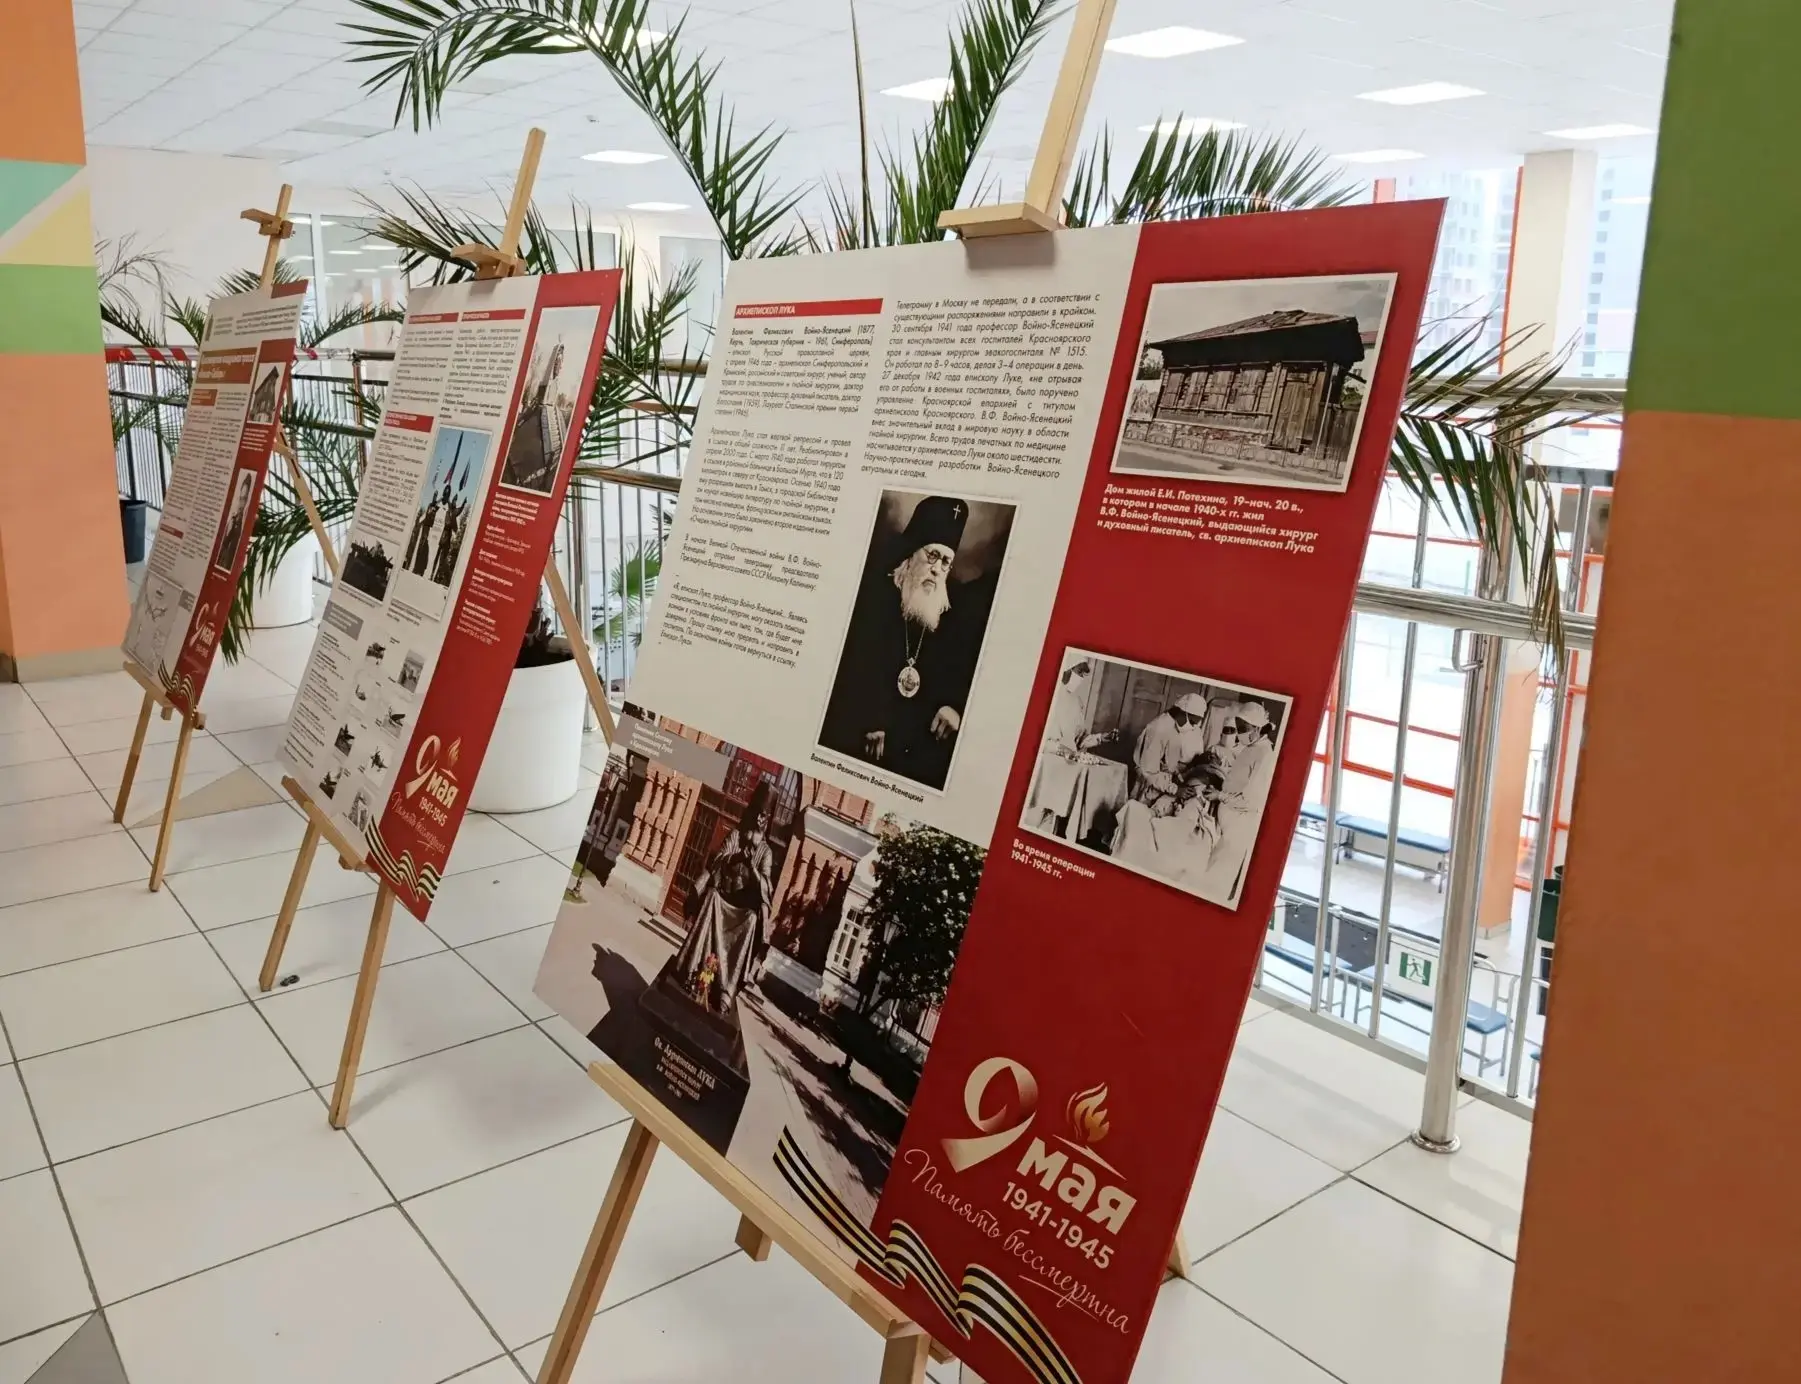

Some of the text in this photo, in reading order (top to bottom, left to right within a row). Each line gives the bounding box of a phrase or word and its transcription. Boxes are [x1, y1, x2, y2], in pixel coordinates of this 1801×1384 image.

[1104, 484, 1124, 494] Дом
[1125, 488, 1156, 496] жилой
[1157, 489, 1175, 499] Е.И.
[1109, 498, 1147, 508] котором
[1155, 503, 1190, 512] начале
[1193, 504, 1226, 516] 1940-х
[1242, 512, 1264, 520] жил
[1099, 506, 1118, 516] В.Ф.
[1208, 521, 1275, 534] выдающийся
[1279, 529, 1317, 541] хирург
[1103, 520, 1148, 531] духовный
[1198, 532, 1211, 540] св.
[1214, 534, 1282, 548] архиепископ
[1284, 539, 1314, 553] Лука
[405, 735, 459, 808] 9 мая
[810, 752, 923, 802] Валентин Феликсович Войно-Ясенецкий
[419, 796, 448, 827] 1941-1945
[1013, 838, 1095, 878] Во время операции
[941, 1057, 1137, 1235] 9 мая
[904, 1149, 1130, 1333] Память бессмертна
[1002, 1181, 1114, 1269] 1941-1945
